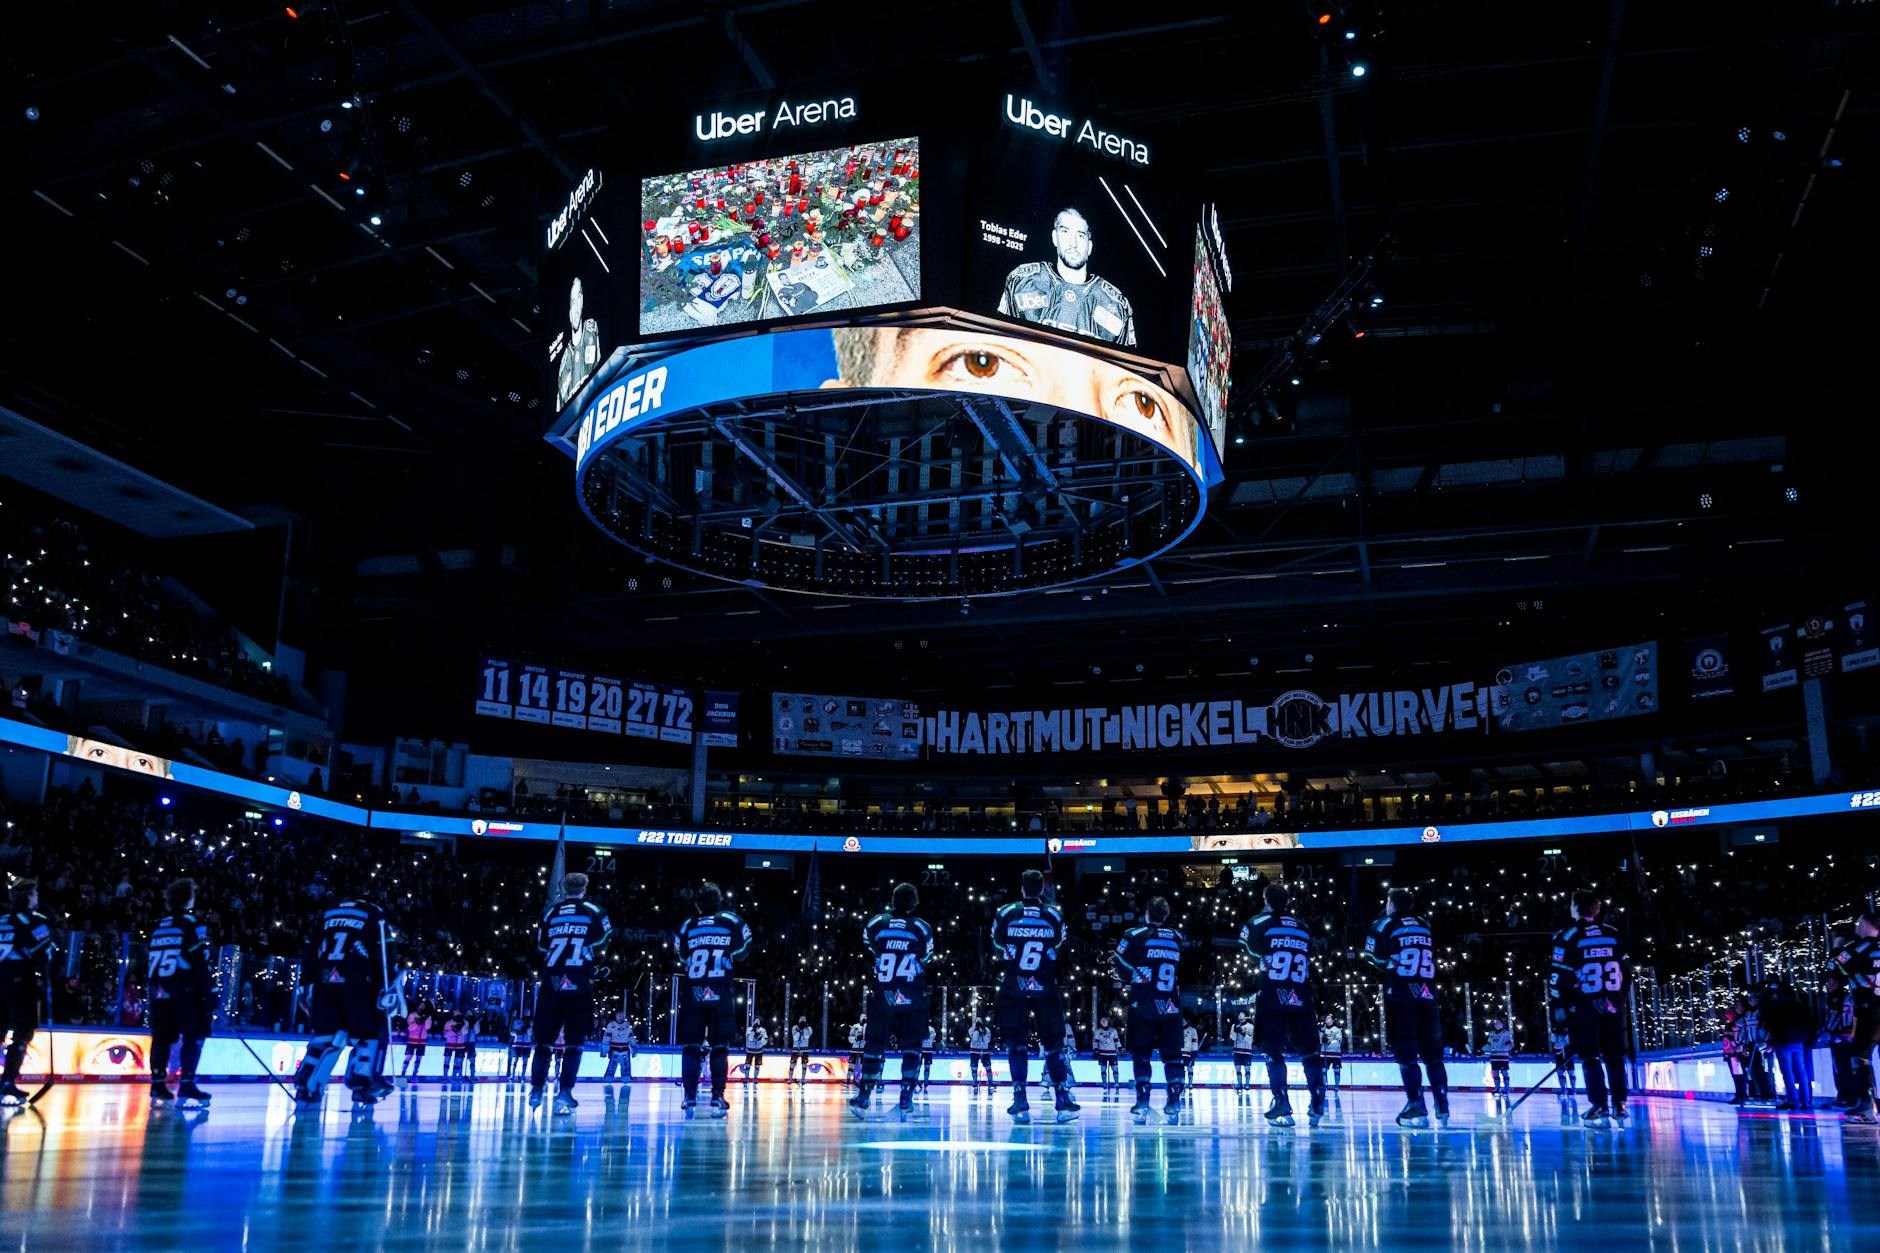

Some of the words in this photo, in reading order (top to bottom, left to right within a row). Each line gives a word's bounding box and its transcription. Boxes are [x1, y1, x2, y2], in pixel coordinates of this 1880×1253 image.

[697, 111, 766, 140] Uber
[773, 97, 856, 129] Arena
[1006, 94, 1072, 138] Uber
[1077, 119, 1150, 165] Arena
[547, 205, 568, 248] Uber
[568, 168, 594, 219] Arena
[980, 220, 1008, 236] Tobias
[1008, 228, 1028, 242] Eder
[983, 232, 1001, 245] 1998
[1005, 239, 1024, 251] 2025
[594, 366, 668, 443] EDER
[483, 667, 510, 703] 11
[520, 673, 550, 708] 14
[556, 679, 587, 713] 19
[590, 683, 623, 719] 20
[627, 689, 659, 724] 27
[662, 694, 694, 729] 72
[706, 710, 736, 718] JACKSON
[937, 707, 1107, 754] HARTMUT
[1121, 700, 1258, 750] NICKEL
[1339, 680, 1478, 739] KURVE
[638, 831, 665, 843] #22
[666, 832, 697, 845] TOBI
[698, 834, 732, 846] EDER
[586, 856, 617, 875] 214
[328, 932, 348, 960] 1
[885, 940, 910, 950] KIRK
[1007, 927, 1055, 938] WISSMANN
[1398, 936, 1432, 947] TIFFELS
[148, 949, 181, 978] 75
[547, 937, 584, 967] 71
[688, 949, 725, 979] 81
[1019, 941, 1044, 971] 6
[1268, 951, 1307, 983] 93
[1397, 948, 1435, 979] 95
[878, 953, 917, 982] 94
[1156, 963, 1175, 991] 9
[1581, 961, 1621, 993] 33
